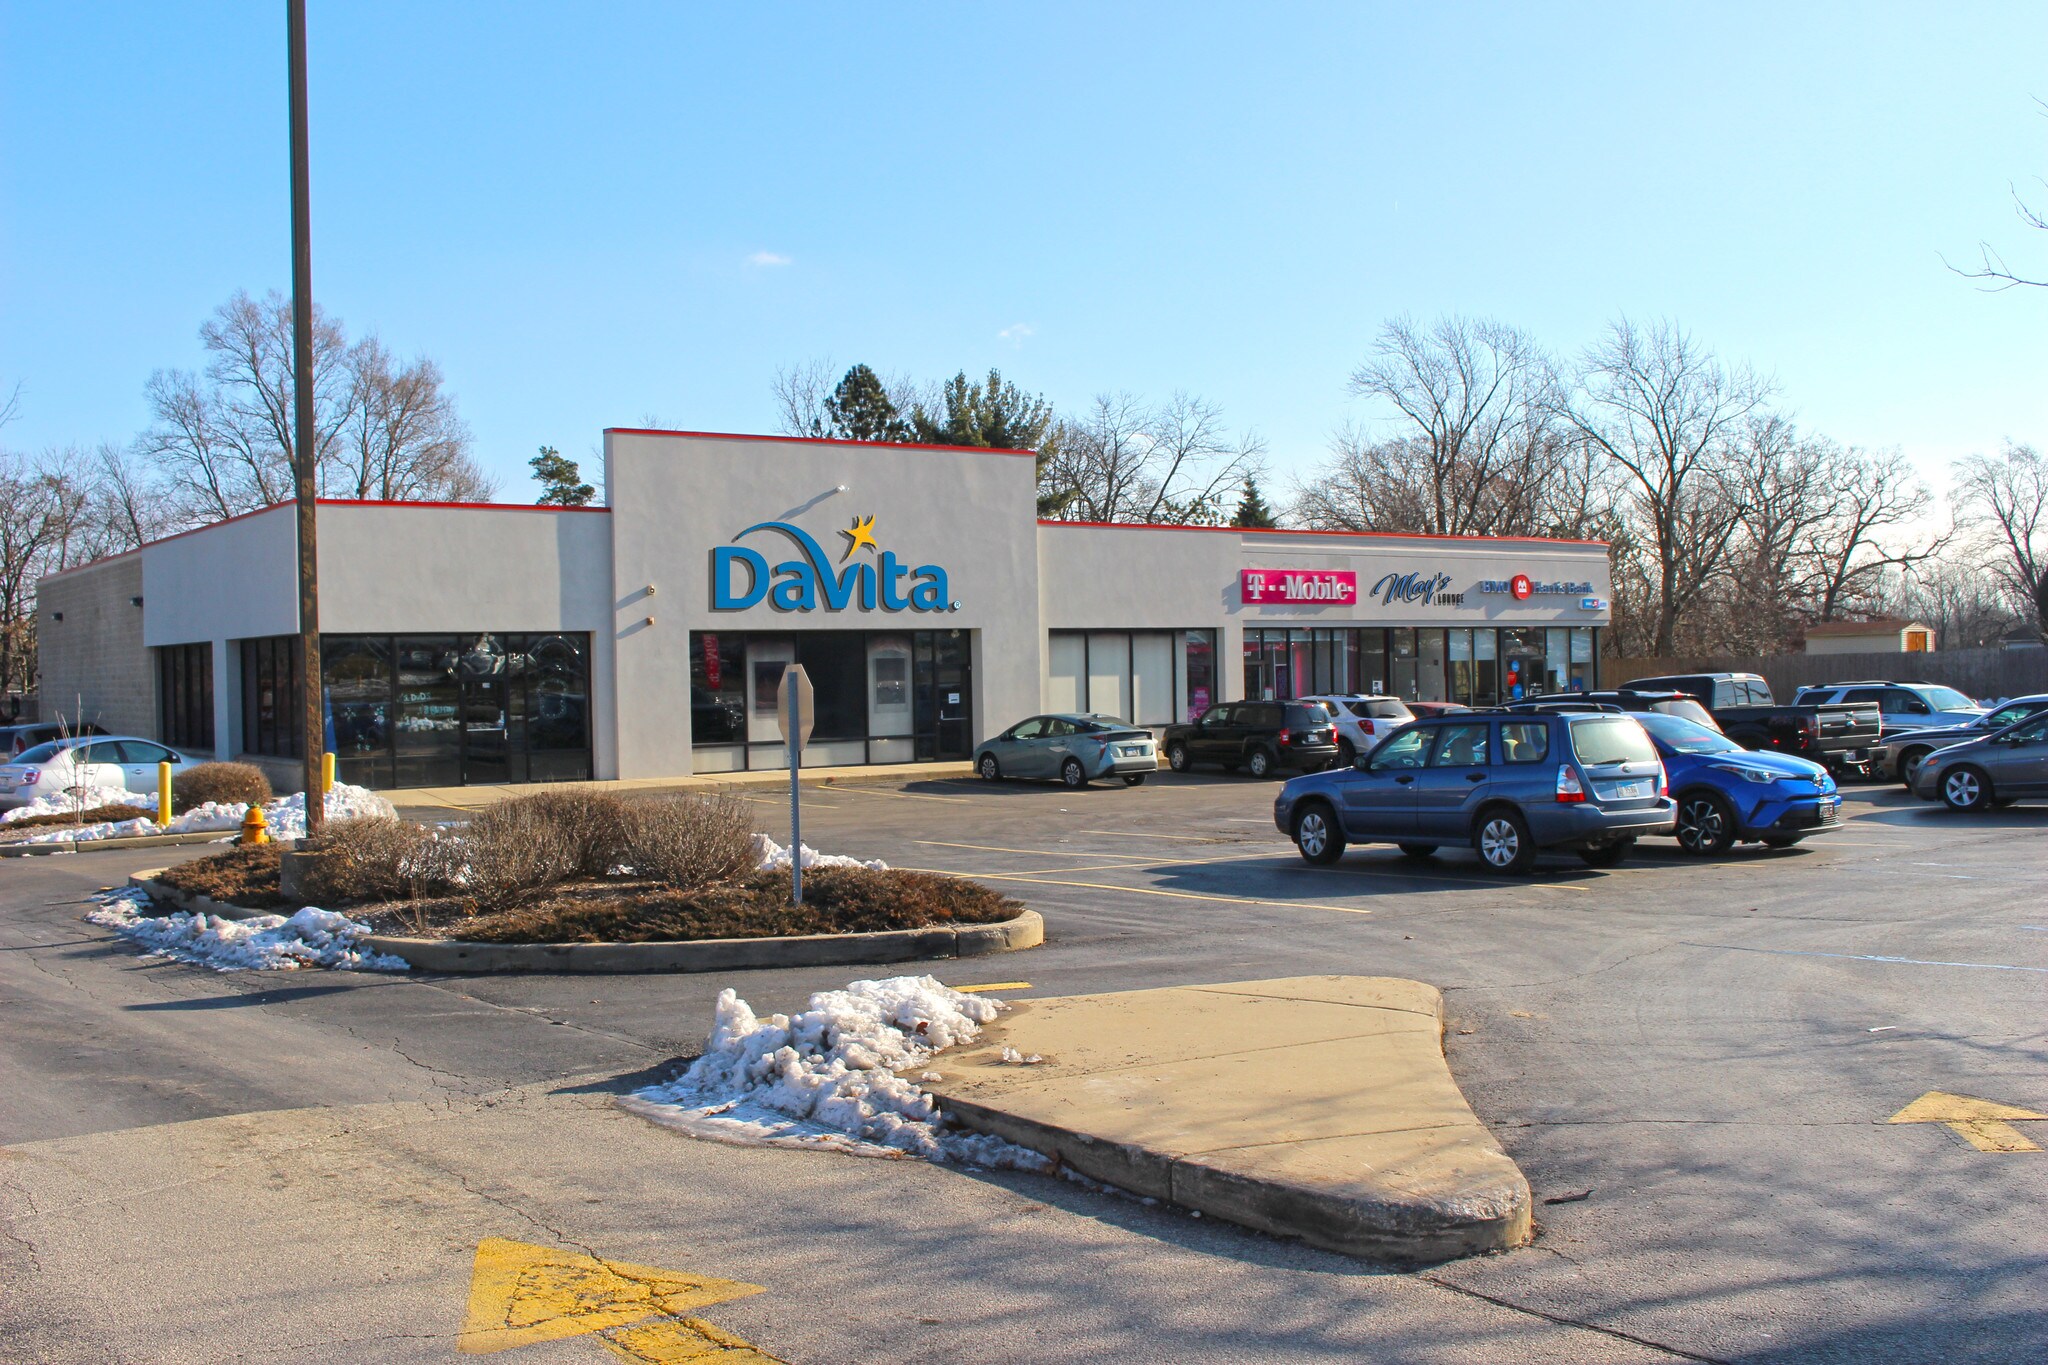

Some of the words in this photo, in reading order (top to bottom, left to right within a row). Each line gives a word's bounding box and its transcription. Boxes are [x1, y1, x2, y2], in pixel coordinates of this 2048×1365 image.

[714, 519, 949, 609] DaVita
[1374, 572, 1453, 604] May's
[1480, 581, 1511, 593] BMO
[1533, 581, 1566, 594] Harris
[1567, 582, 1594, 594] Bank
